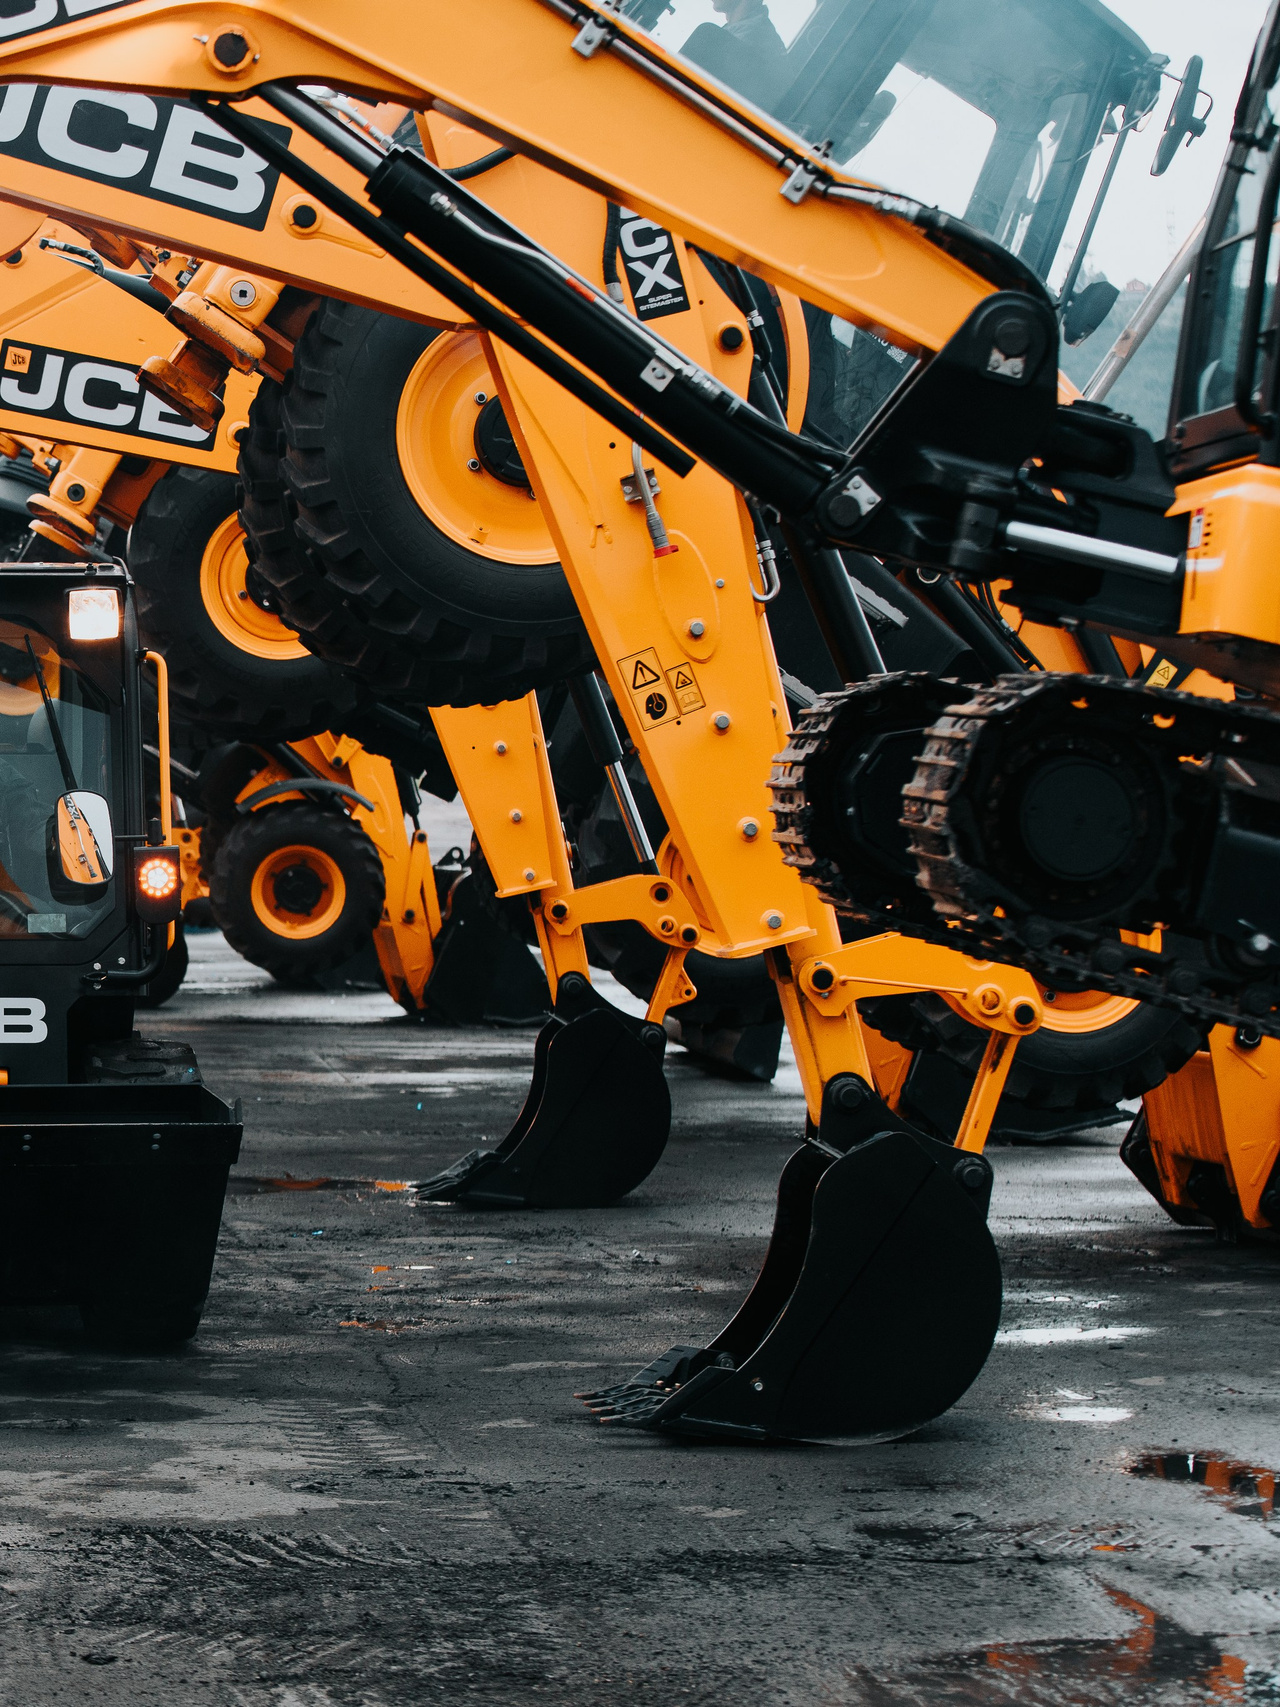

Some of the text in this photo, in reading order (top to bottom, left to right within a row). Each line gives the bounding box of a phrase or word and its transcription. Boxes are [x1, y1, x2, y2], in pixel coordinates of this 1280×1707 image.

[620, 206, 683, 299] CX
[639, 296, 684, 311] SITEMASTER
[648, 293, 672, 303] SUPER
[12, 353, 26, 365] JCB
